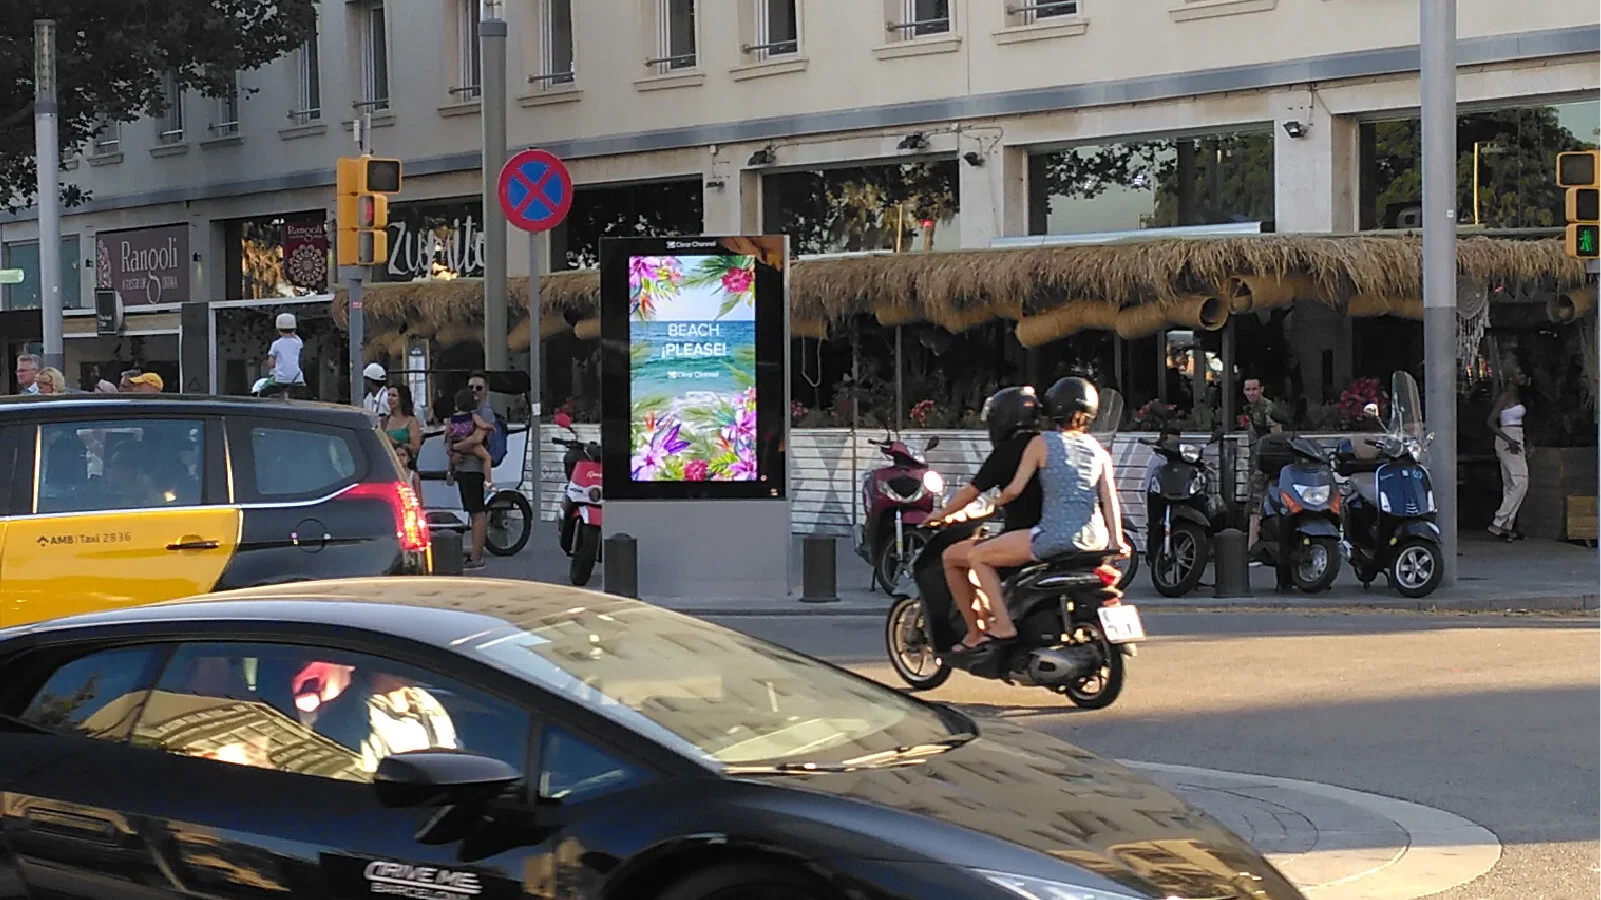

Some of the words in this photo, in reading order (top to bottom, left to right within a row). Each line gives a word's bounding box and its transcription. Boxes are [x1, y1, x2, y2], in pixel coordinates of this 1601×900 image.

[287, 225, 323, 243] Rangoli
[692, 240, 717, 248] Channel
[121, 236, 178, 304] Rangoli
[667, 322, 720, 337] BEACH
[50, 534, 74, 545] AMB
[80, 533, 100, 544] Taxi
